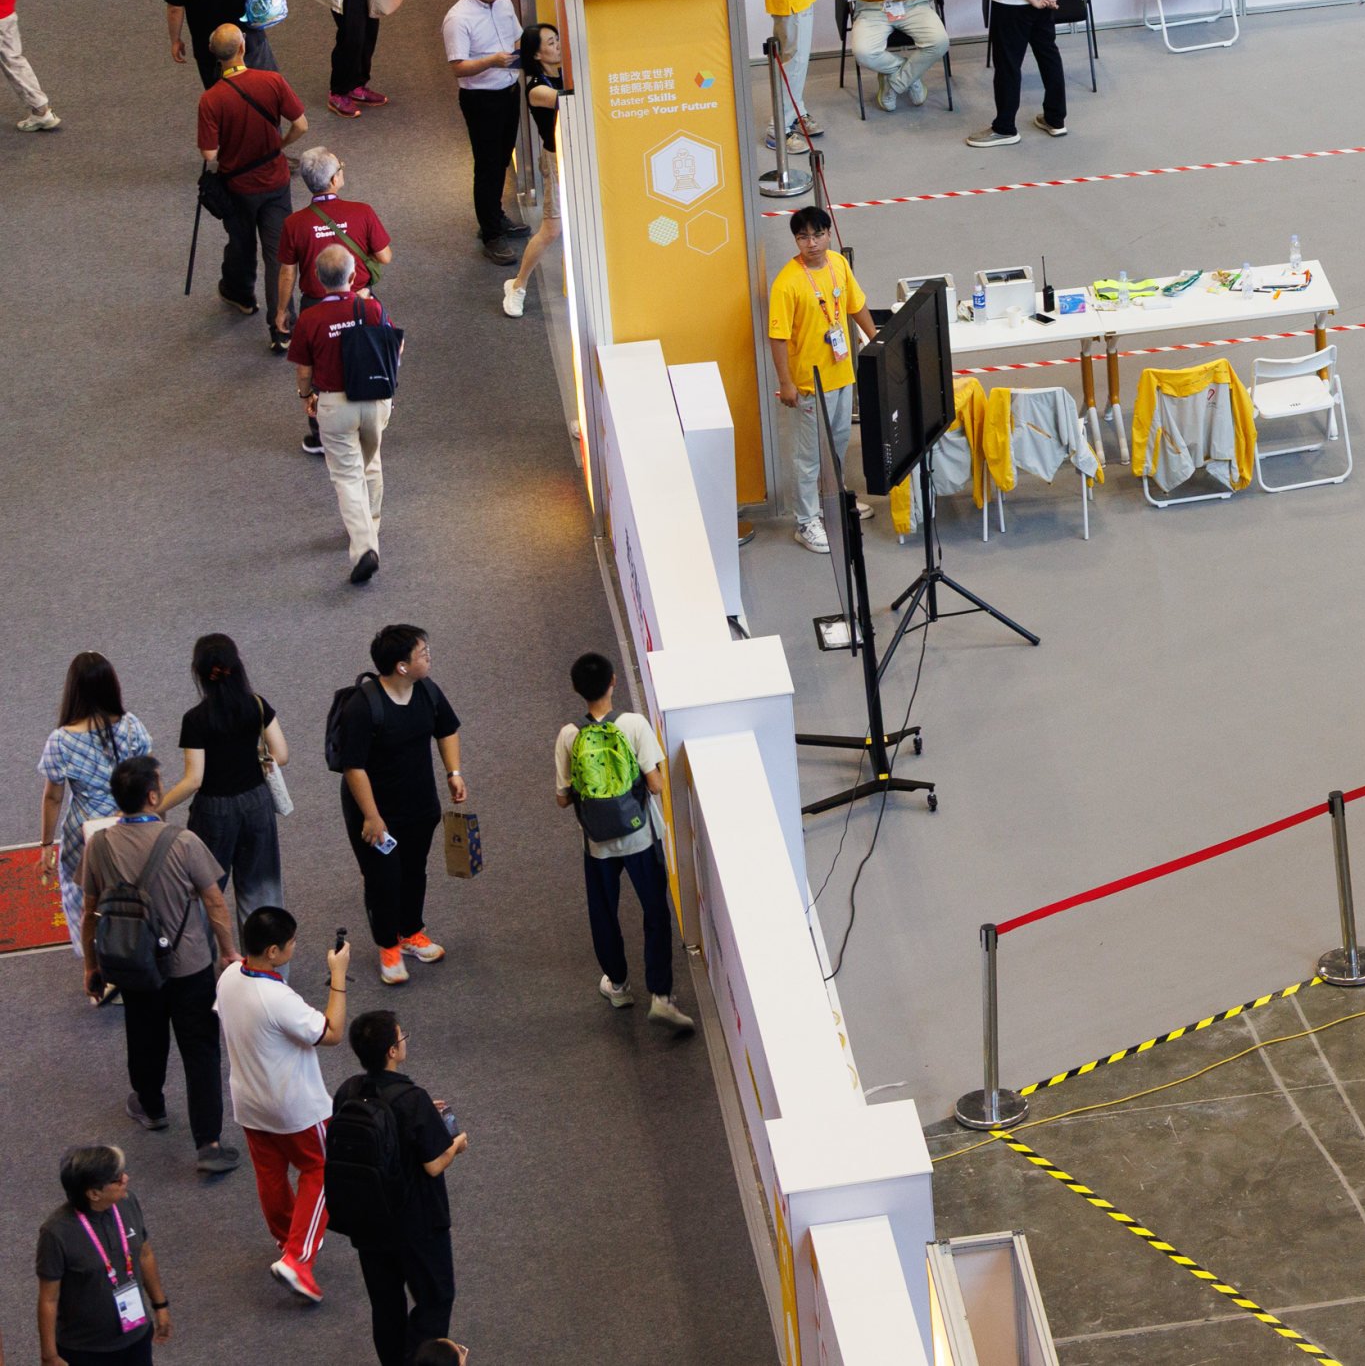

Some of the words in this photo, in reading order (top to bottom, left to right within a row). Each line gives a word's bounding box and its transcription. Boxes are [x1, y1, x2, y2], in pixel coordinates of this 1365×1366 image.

[608, 67, 673, 84] 技能改变世界
[610, 96, 645, 107] Master
[647, 92, 677, 103] Skills
[611, 107, 650, 119] Change
[652, 104, 679, 115] Your
[681, 100, 718, 112] Future
